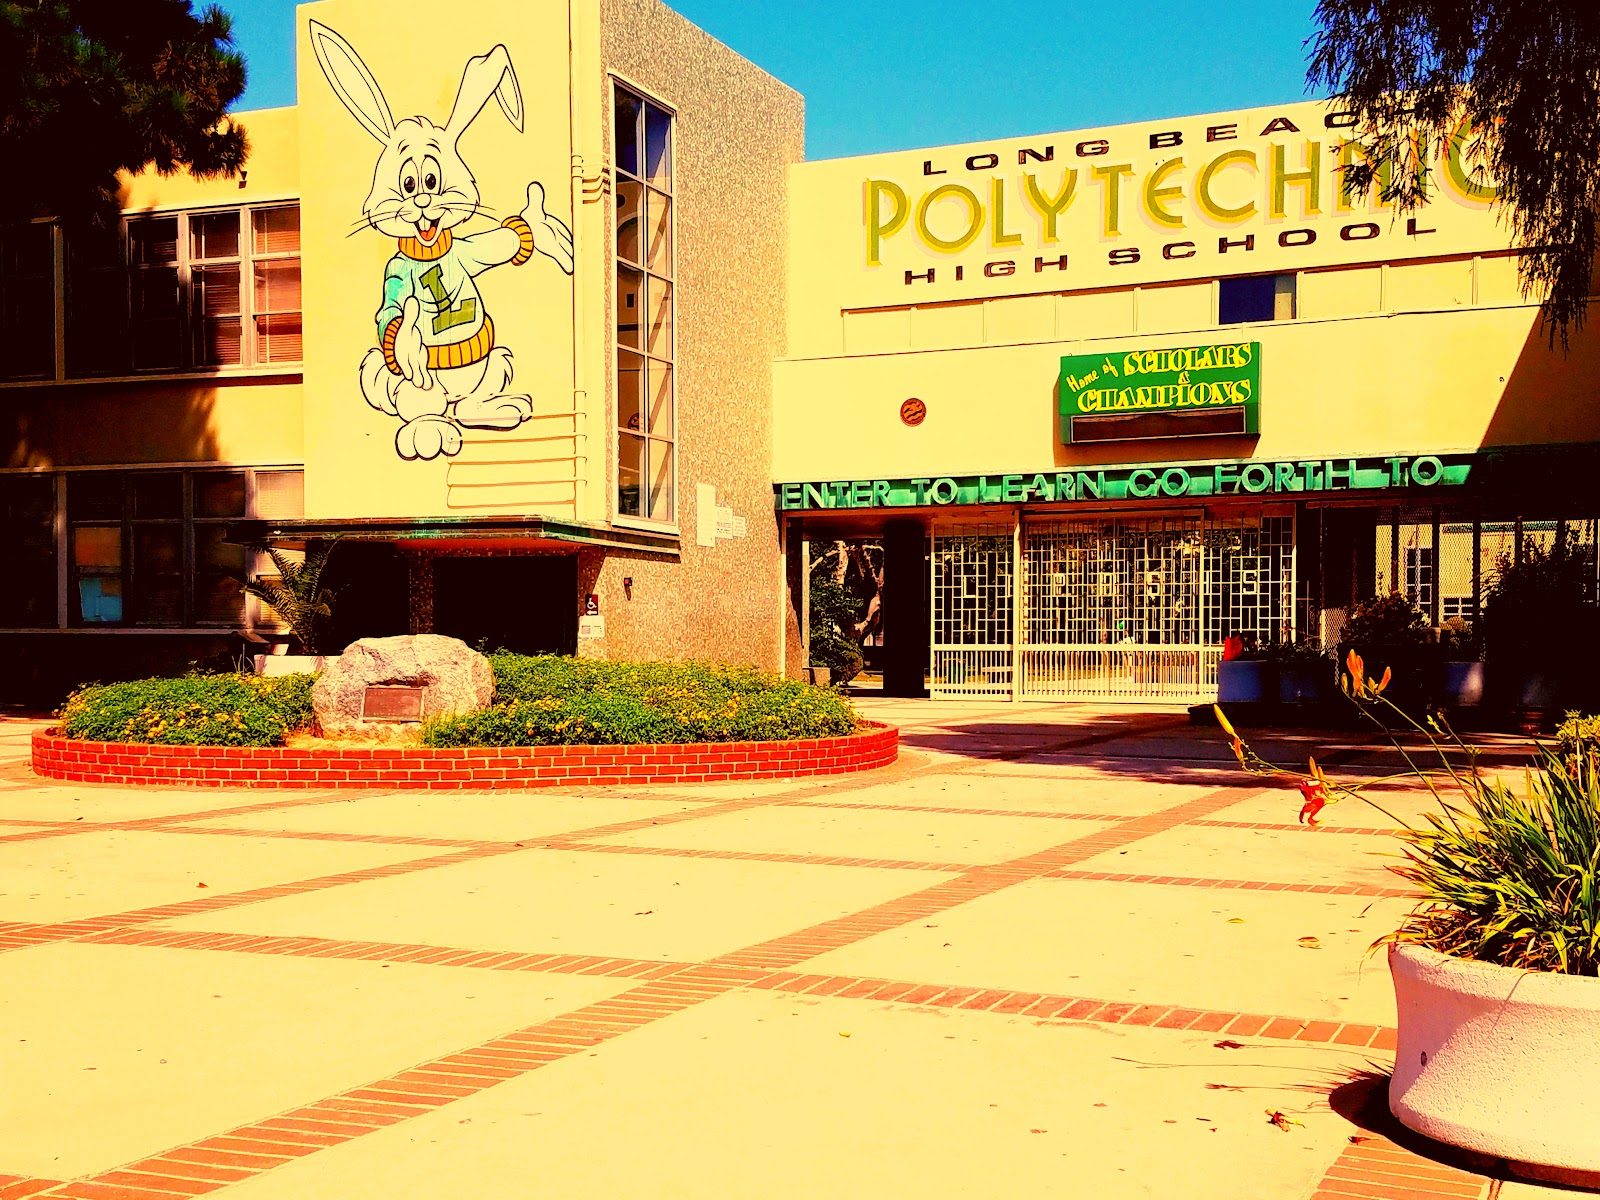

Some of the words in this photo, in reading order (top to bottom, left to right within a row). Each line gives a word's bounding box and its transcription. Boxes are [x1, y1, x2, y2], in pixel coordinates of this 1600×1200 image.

[923, 139, 1110, 176] LONG
[1150, 105, 1416, 150] BEAC
[904, 255, 1068, 286] HIGH
[1108, 218, 1437, 266] SCHOOL
[418, 263, 477, 336] L
[1066, 370, 1100, 393] Home
[1102, 356, 1119, 378] of
[1123, 343, 1252, 377] SCHOLARS
[1177, 370, 1191, 385] &
[1077, 379, 1252, 413] CHAMPIONS
[781, 480, 891, 510] ENTER
[911, 477, 959, 506] TO
[978, 471, 1106, 503] LEARN
[1127, 468, 1191, 498] GO
[1214, 459, 1357, 493] FORTH
[1384, 455, 1445, 488] TO
